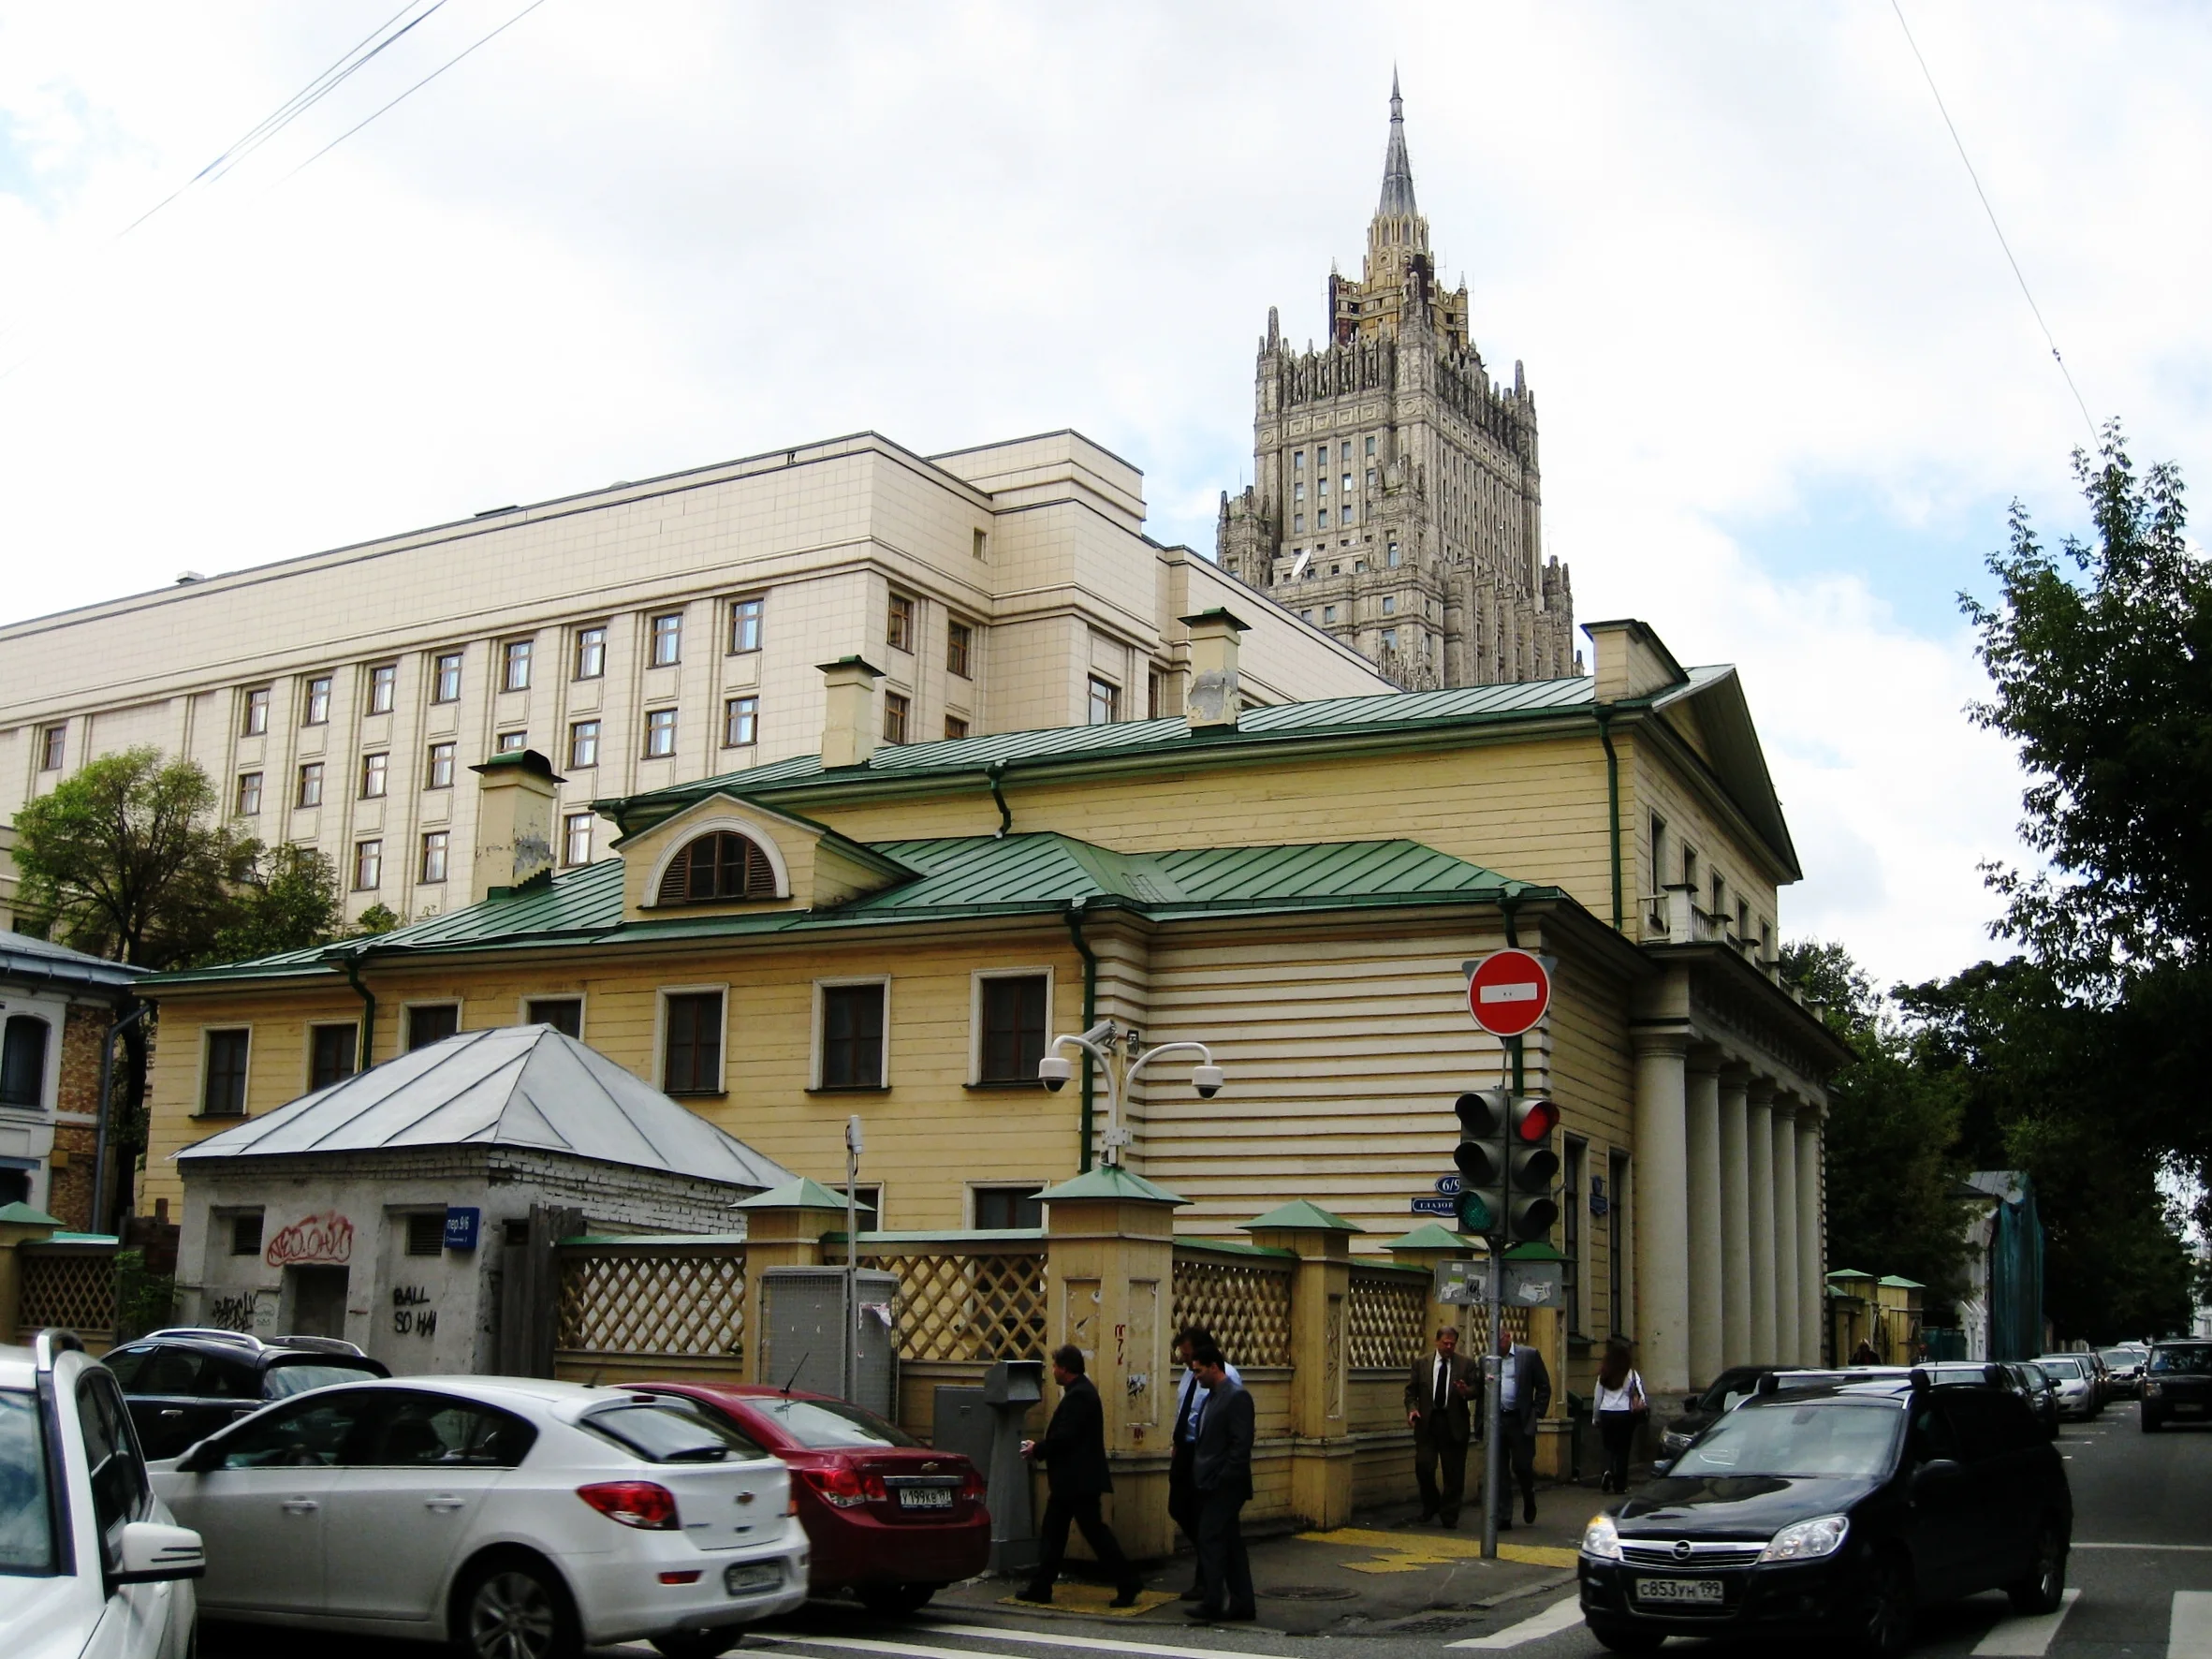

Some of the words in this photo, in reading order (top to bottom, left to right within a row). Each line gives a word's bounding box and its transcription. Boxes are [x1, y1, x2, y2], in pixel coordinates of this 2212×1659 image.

[1443, 1179, 1460, 1191] 6/9
[393, 1285, 431, 1307] BALL
[394, 1311, 412, 1335] SO
